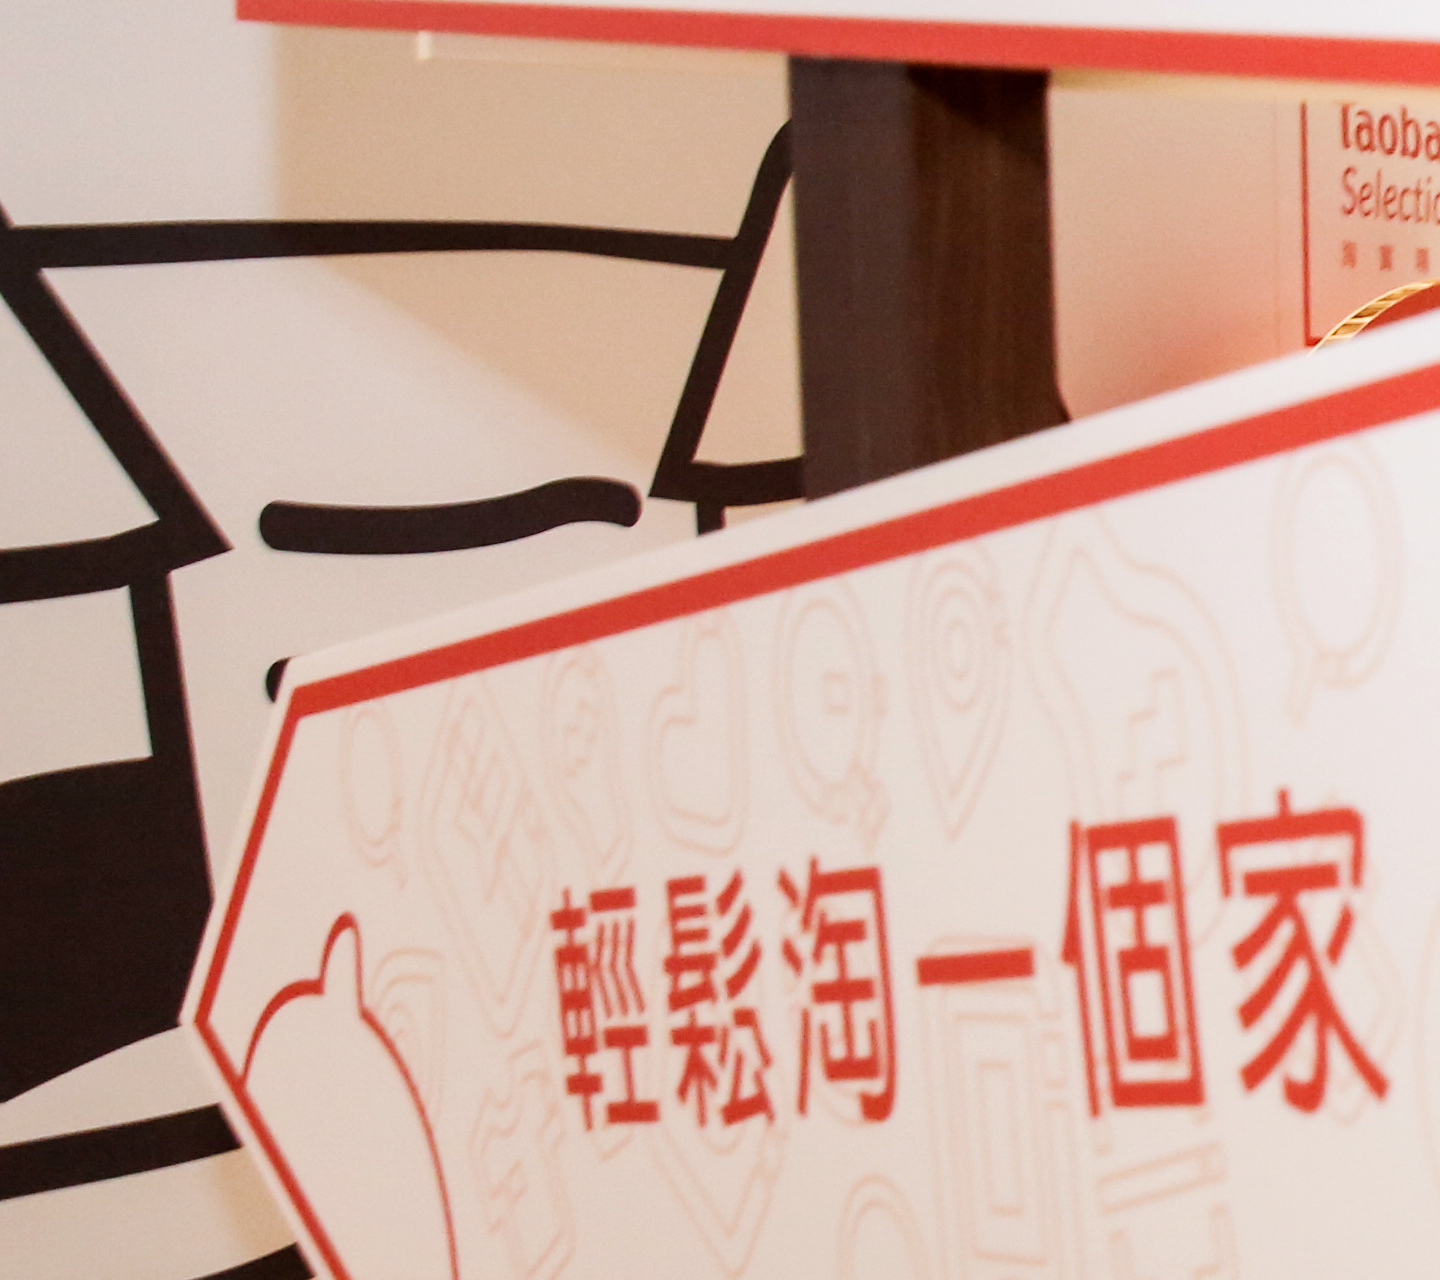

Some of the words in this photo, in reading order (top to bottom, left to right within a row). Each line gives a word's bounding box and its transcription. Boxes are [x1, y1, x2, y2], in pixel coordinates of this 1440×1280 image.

[549, 787, 1391, 1131] 輕鬆淘一個家
